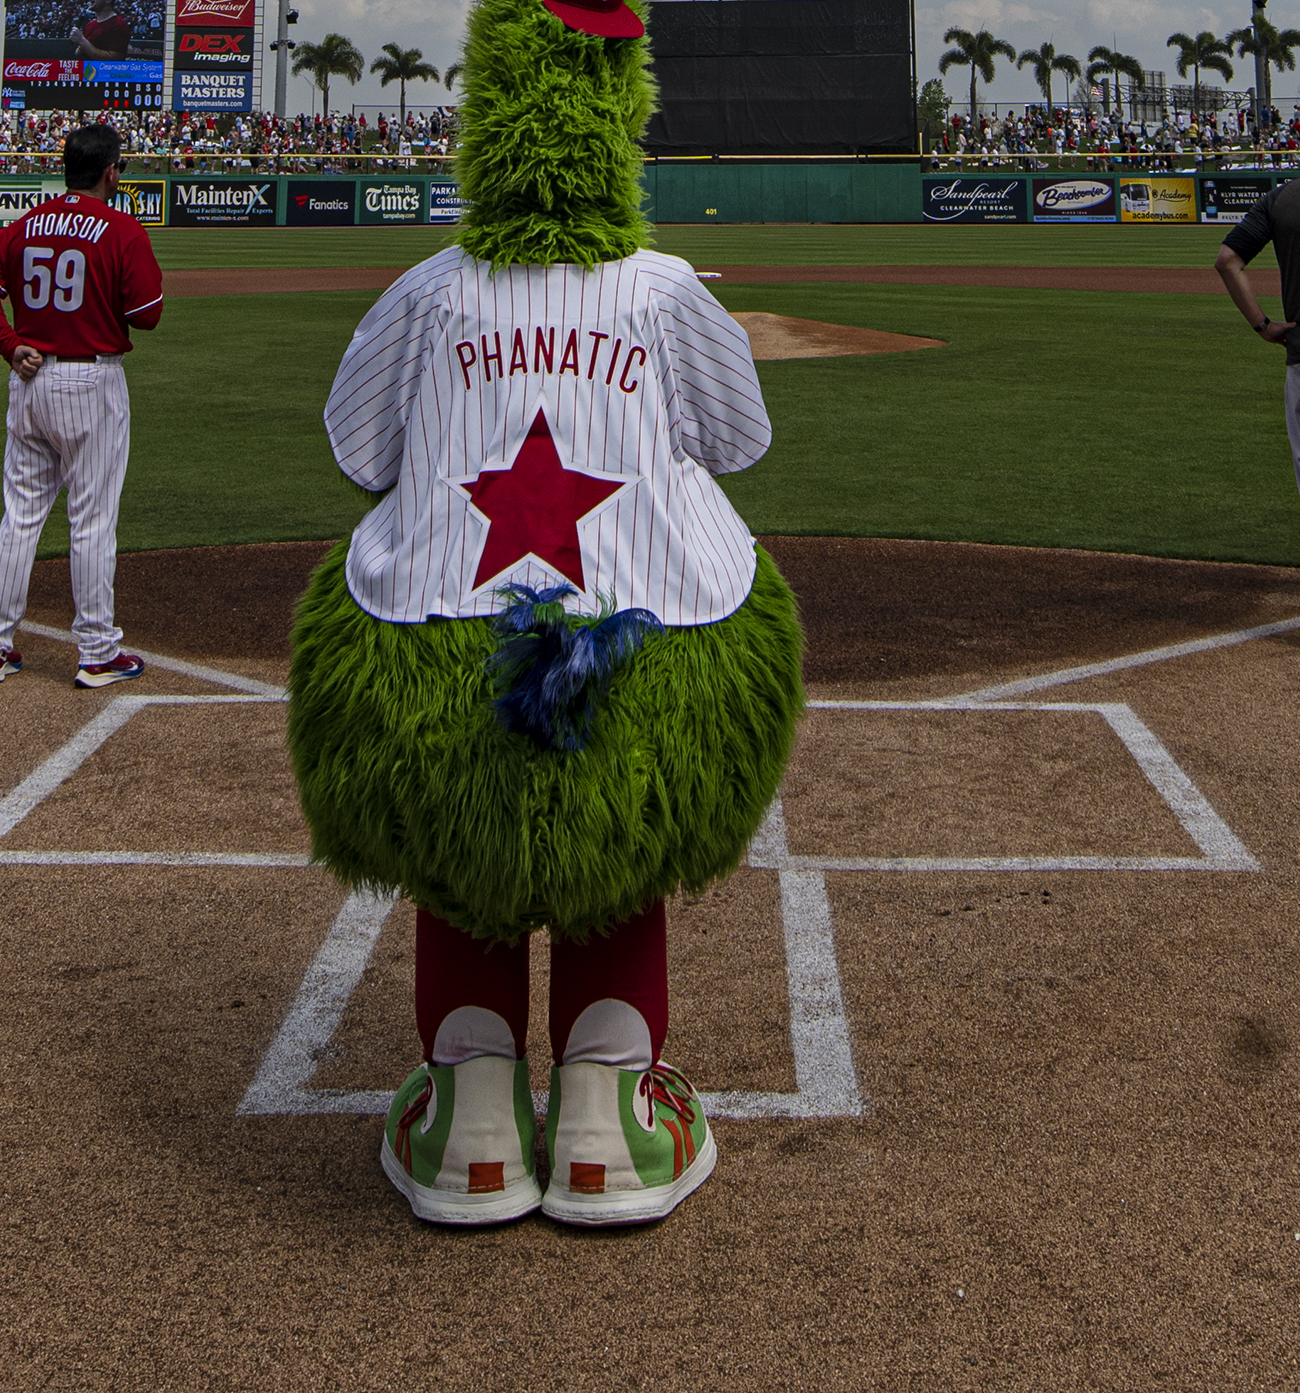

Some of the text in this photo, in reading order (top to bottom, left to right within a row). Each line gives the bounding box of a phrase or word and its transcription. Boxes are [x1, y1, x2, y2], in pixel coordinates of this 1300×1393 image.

[185, 0, 244, 11] Budweiser
[178, 34, 246, 52] DEX
[59, 60, 79, 68] TASTE
[193, 52, 250, 63] imaging
[57, 73, 80, 81] FEELING
[181, 74, 246, 87] BANQUET
[181, 88, 245, 98] MASTERS
[383, 185, 417, 194] Tampa Bay
[928, 179, 1018, 206] Sandpearl
[1159, 189, 1192, 202] Academy
[138, 191, 162, 215] SKY
[176, 184, 271, 209] MaintenX
[365, 187, 421, 212] Times
[1042, 187, 1112, 208] Beachcomber
[309, 198, 349, 210] Fanatics
[1132, 211, 1189, 221] academybus.com
[25, 213, 109, 244] THOMSON
[23, 246, 86, 312] 59
[455, 326, 647, 393] PHANATIC
